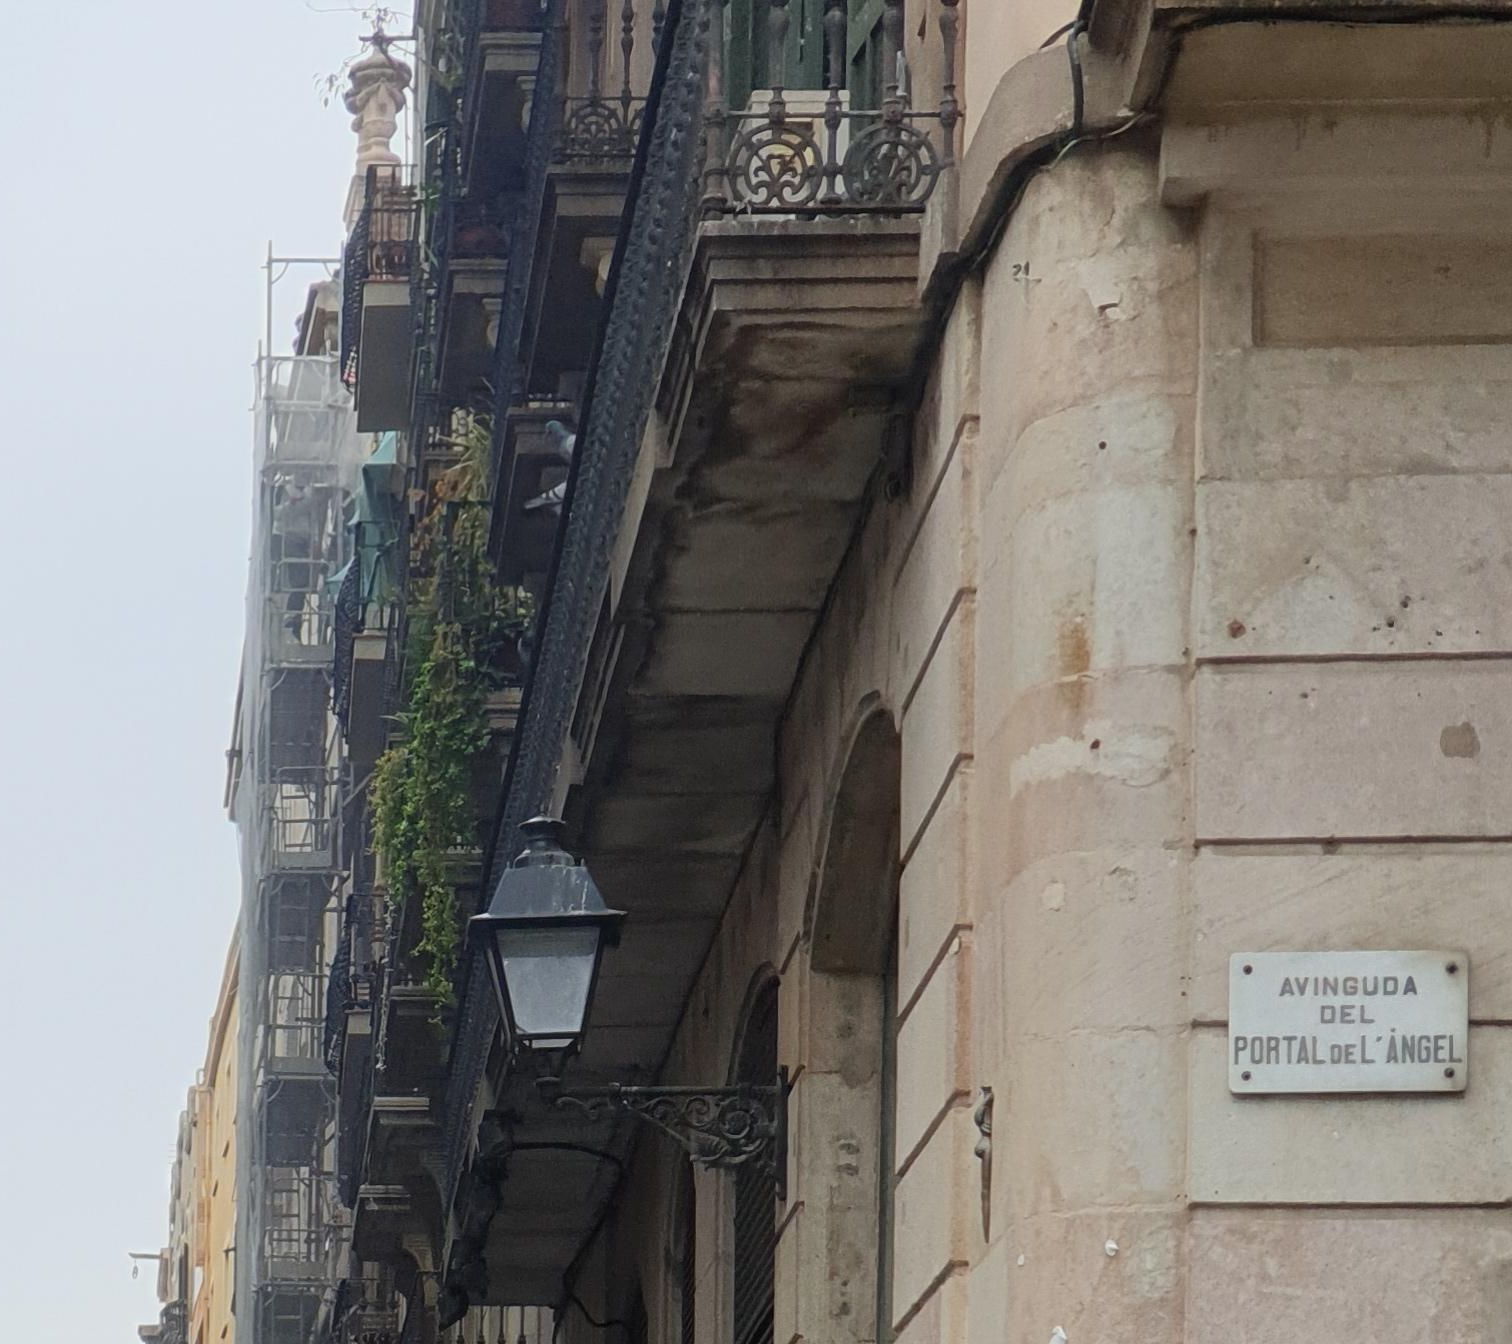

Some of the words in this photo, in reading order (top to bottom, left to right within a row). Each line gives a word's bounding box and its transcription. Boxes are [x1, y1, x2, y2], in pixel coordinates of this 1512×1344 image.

[1279, 976, 1418, 997] AVINGUDA
[1320, 1005, 1375, 1024] DEL
[1234, 1035, 1326, 1065] PORTAL
[1330, 1043, 1357, 1064] DE
